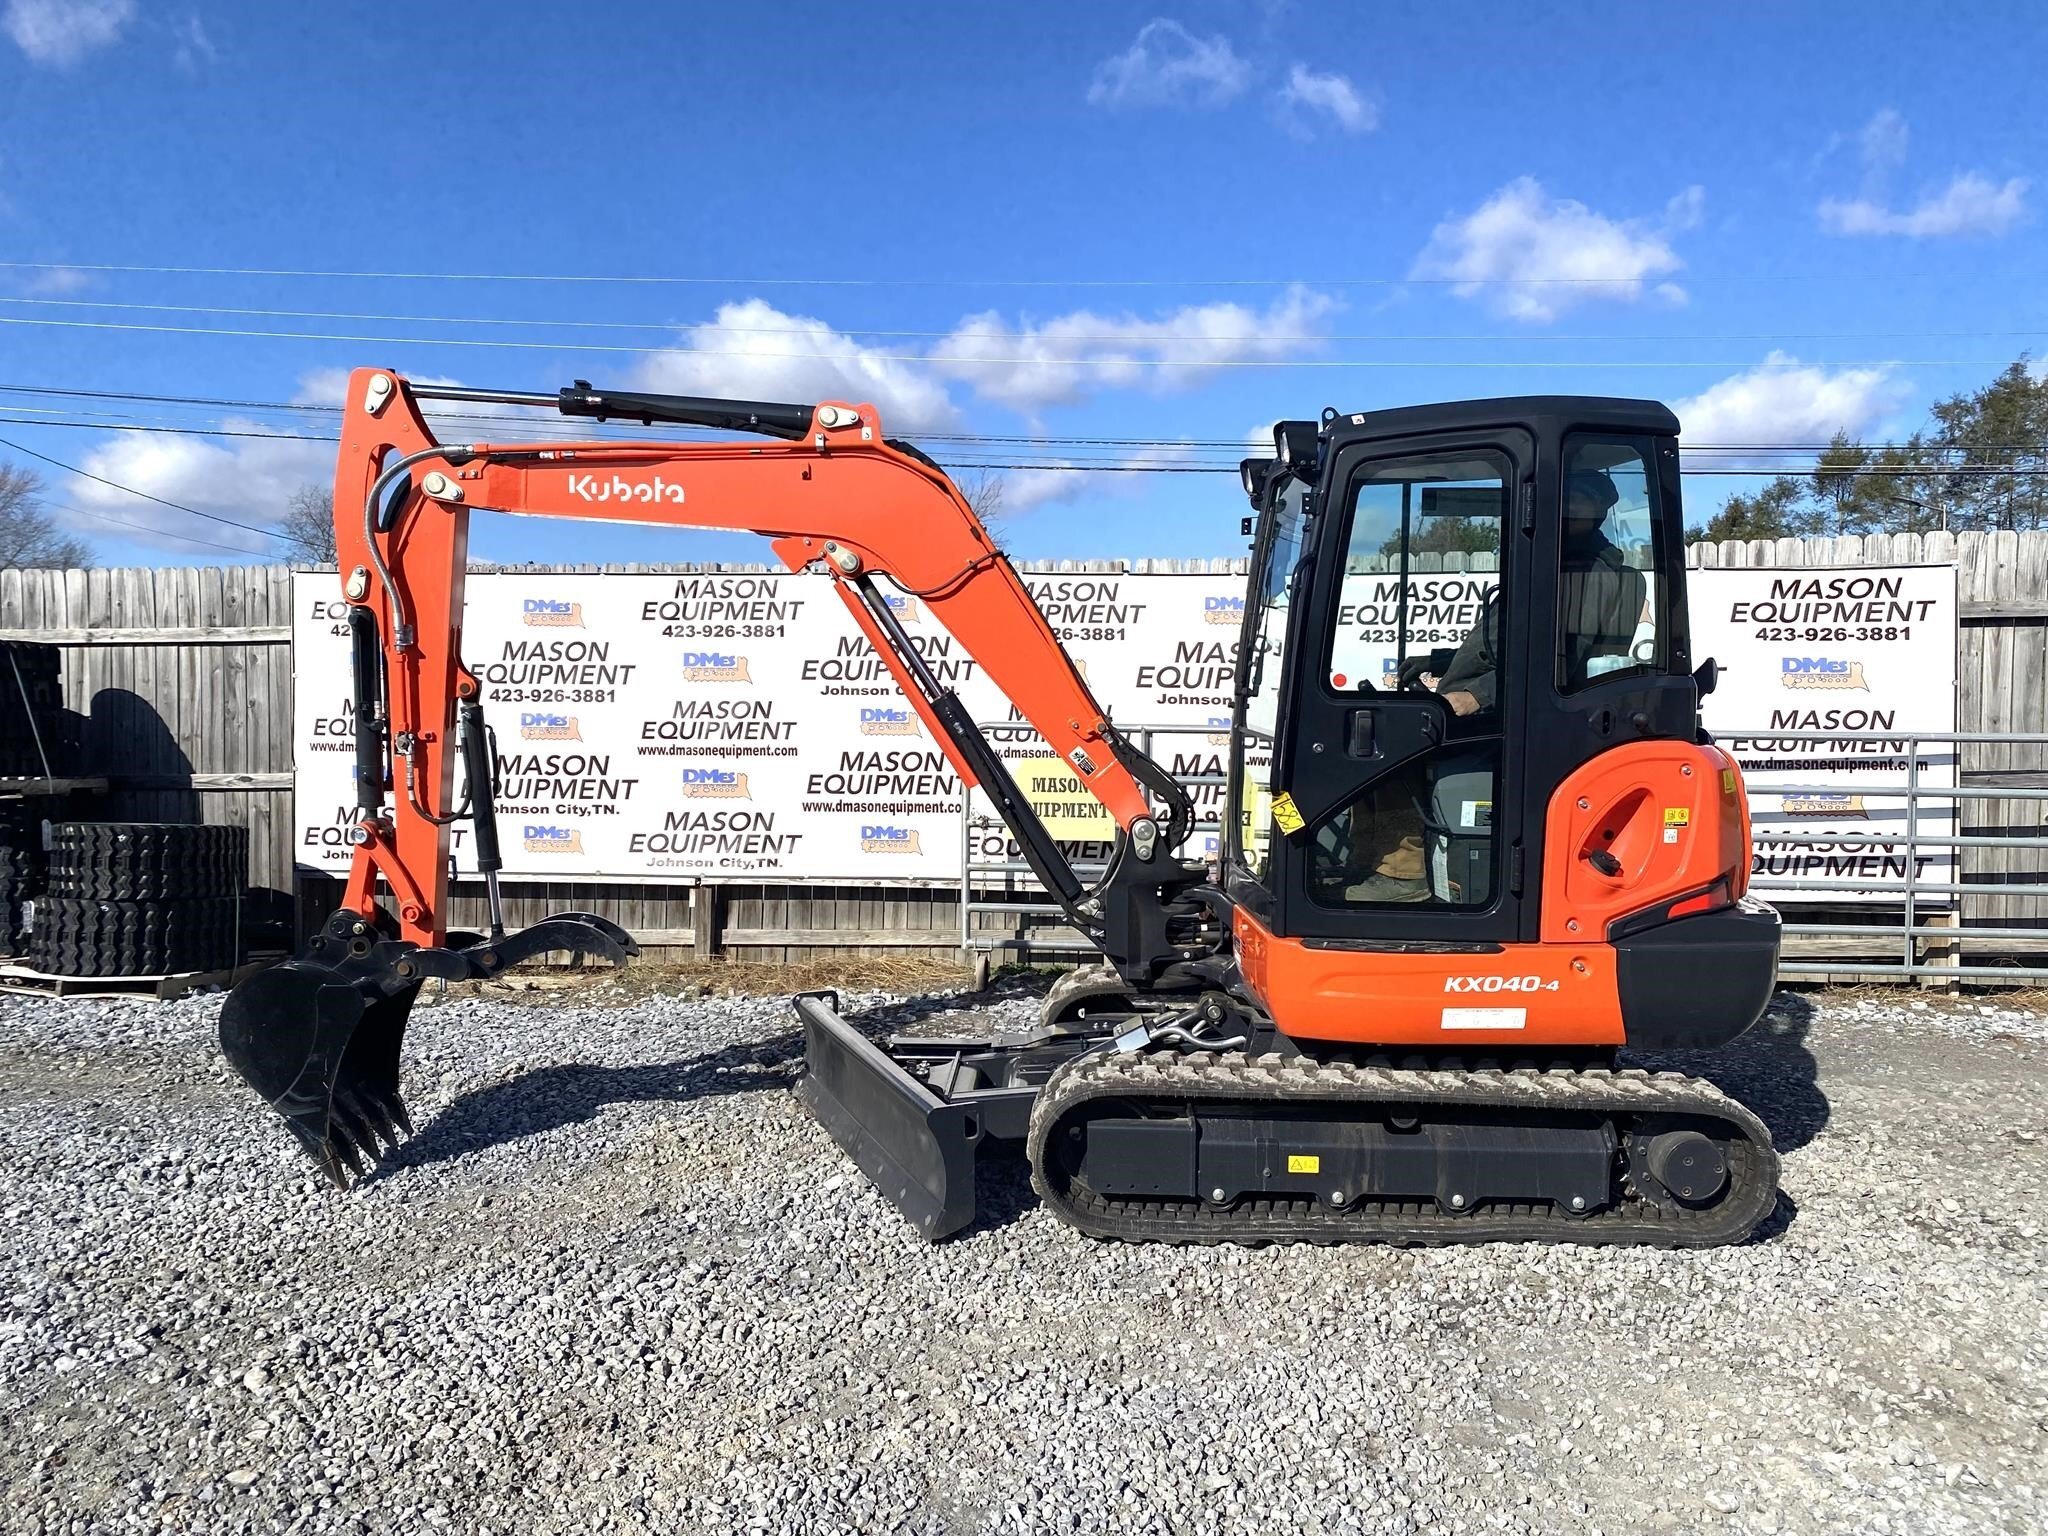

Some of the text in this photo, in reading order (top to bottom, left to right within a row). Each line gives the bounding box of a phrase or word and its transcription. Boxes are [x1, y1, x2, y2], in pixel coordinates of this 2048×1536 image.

[568, 474, 685, 503] Kubota
[674, 579, 778, 599] MASON
[1770, 577, 1903, 600] MASON
[641, 601, 805, 621] EQUIPMENT
[1730, 600, 1937, 623] EQUIPMENT
[662, 624, 786, 638] 423-926-3881
[1755, 626, 1911, 641] 423-926-3881
[502, 640, 609, 662] MASON
[470, 663, 637, 685] EQUIPMENT
[489, 688, 616, 703] 423-926-3881
[820, 685, 890, 696] Johnson
[1156, 693, 1235, 705] Johnson
[672, 700, 773, 719] MASON
[1769, 709, 1896, 730] MASON
[641, 721, 798, 740] EQUIPMENT
[637, 743, 799, 759] www.dmasonequipment.com
[498, 754, 611, 776] MASON
[839, 751, 945, 772] MASON
[494, 803, 550, 814] ohnson
[802, 799, 962, 816] www.dmasonequipment.co
[1032, 802, 1109, 819] UIPMENT
[664, 811, 776, 832] MASON
[628, 833, 803, 854] EQUIPMENT
[646, 857, 714, 868] Johnson
[1444, 975, 1560, 992] KX040-4
